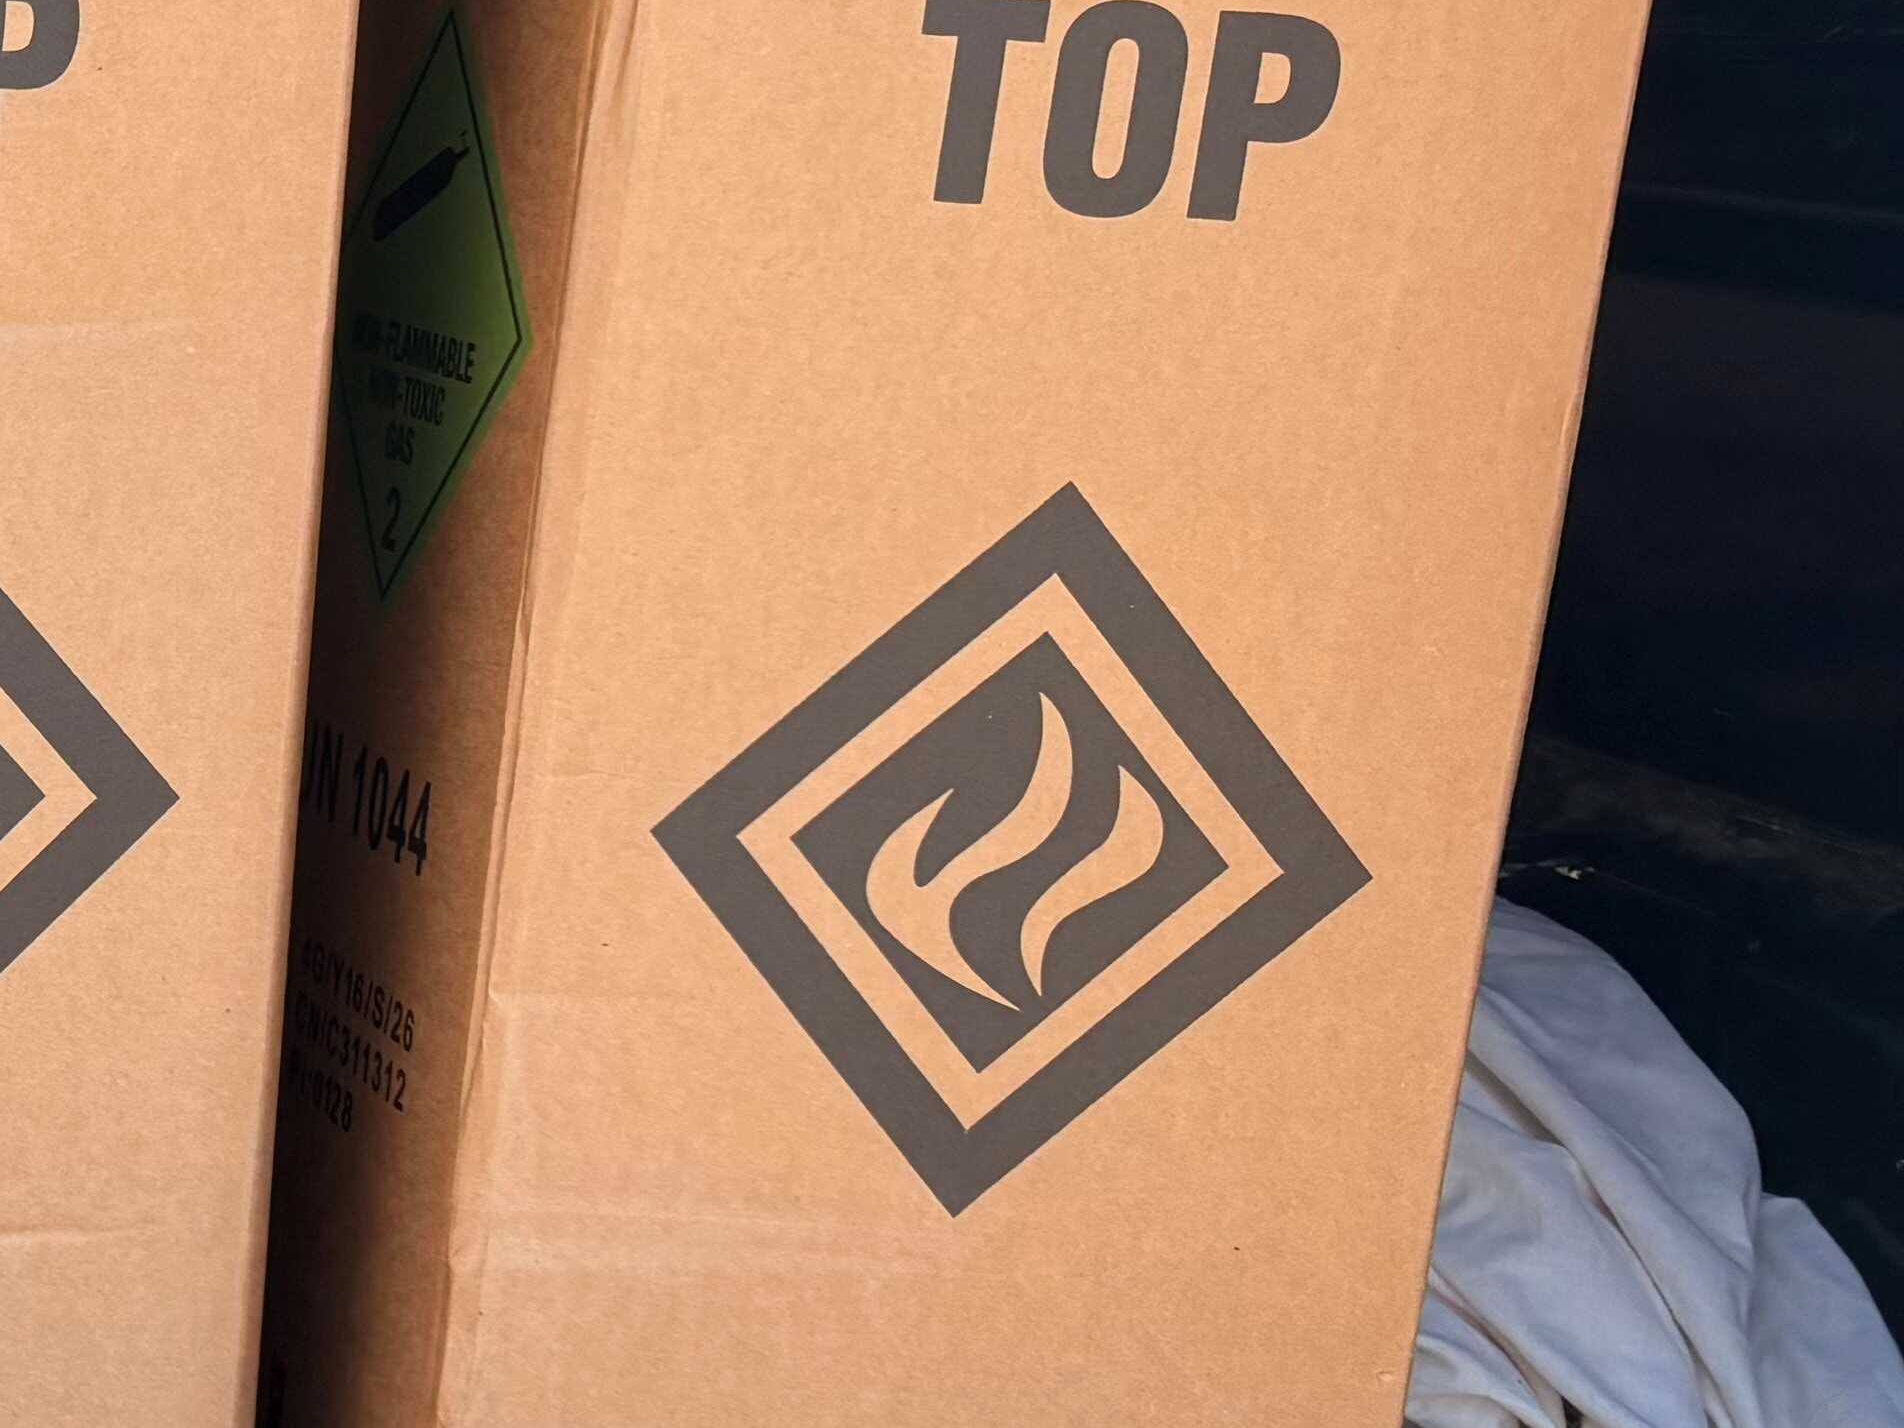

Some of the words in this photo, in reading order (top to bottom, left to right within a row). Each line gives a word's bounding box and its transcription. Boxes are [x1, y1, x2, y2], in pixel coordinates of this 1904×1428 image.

[352, 312, 476, 384] -FLAMMABLE
[368, 365, 445, 426] -TOXIC
[382, 486, 400, 552] 2
[352, 748, 431, 876] 1044
